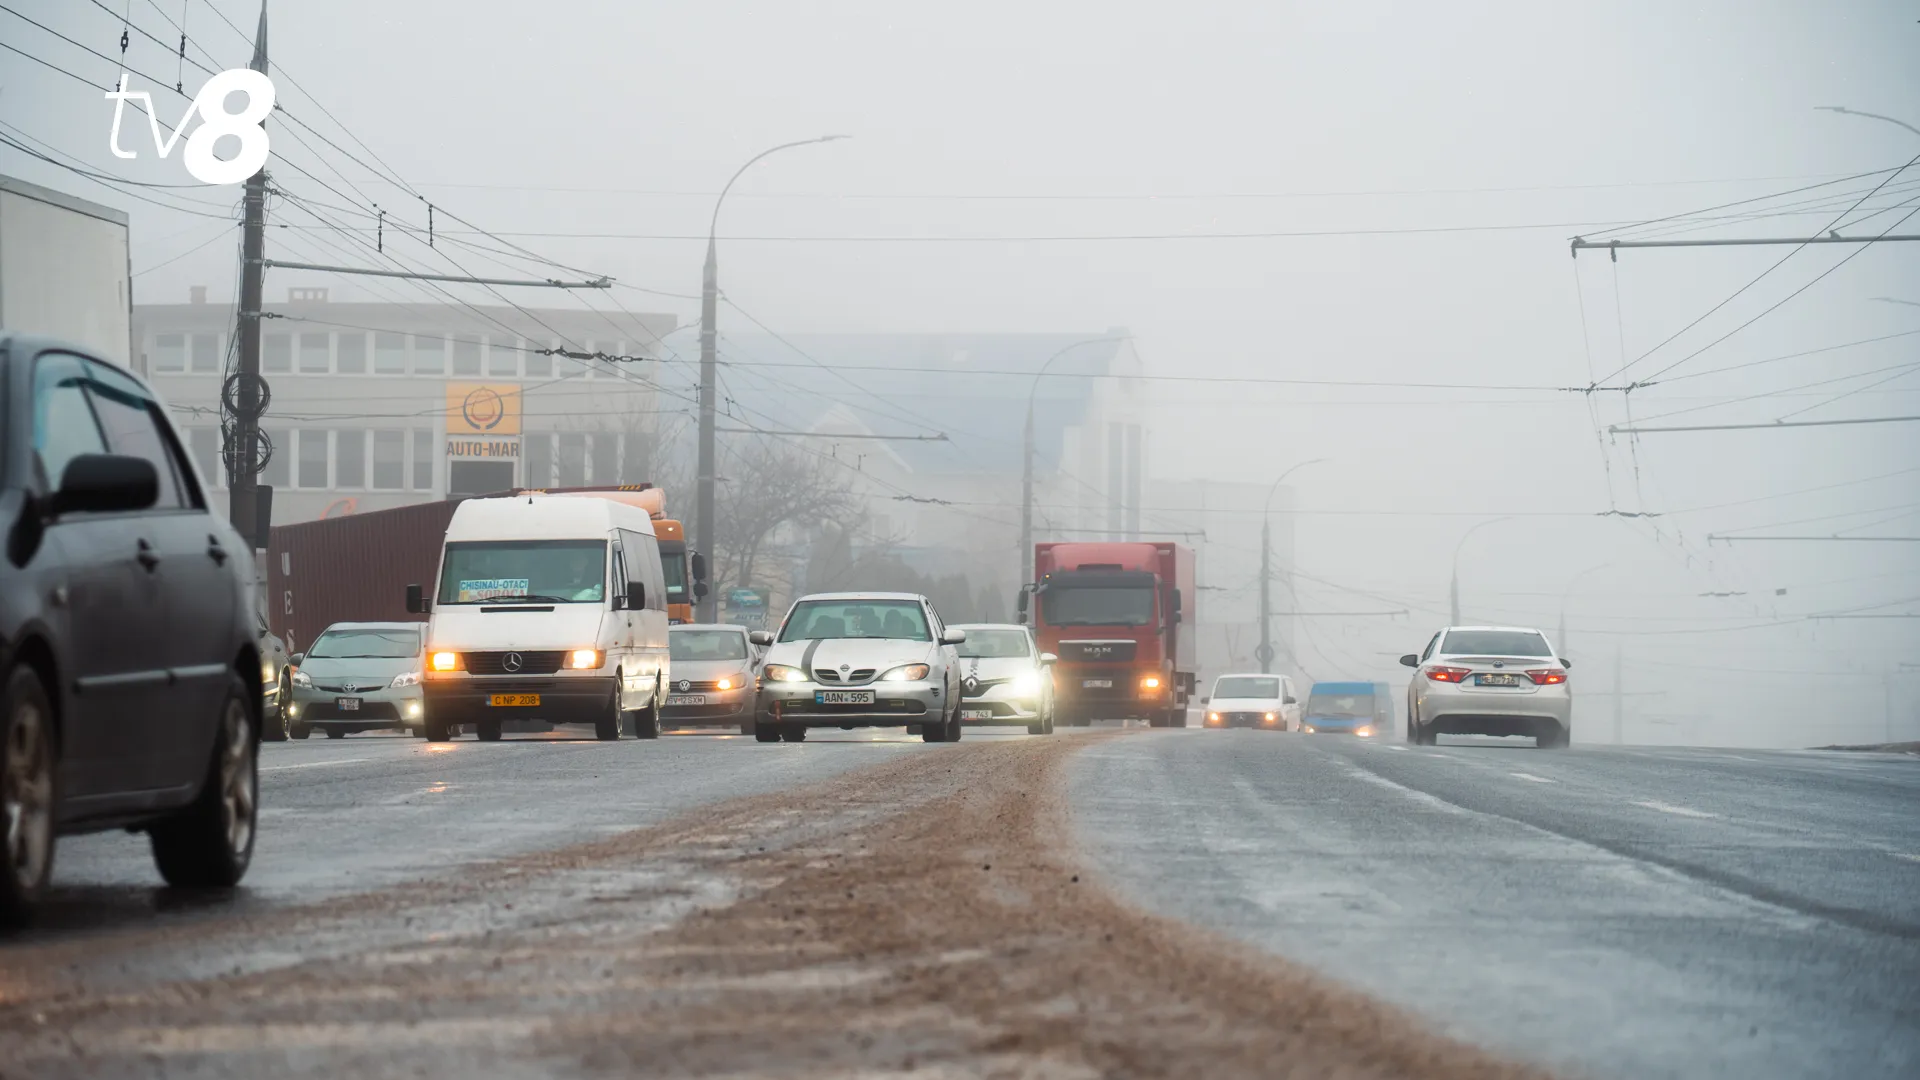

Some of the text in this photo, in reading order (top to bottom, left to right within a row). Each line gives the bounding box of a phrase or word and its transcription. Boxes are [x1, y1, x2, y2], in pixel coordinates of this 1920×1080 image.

[446, 441, 519, 457] AUTO-MAR
[460, 580, 528, 590] CHISINAU-OTACI
[495, 696, 536, 704] C NP 208
[824, 693, 869, 702] AAN 595
